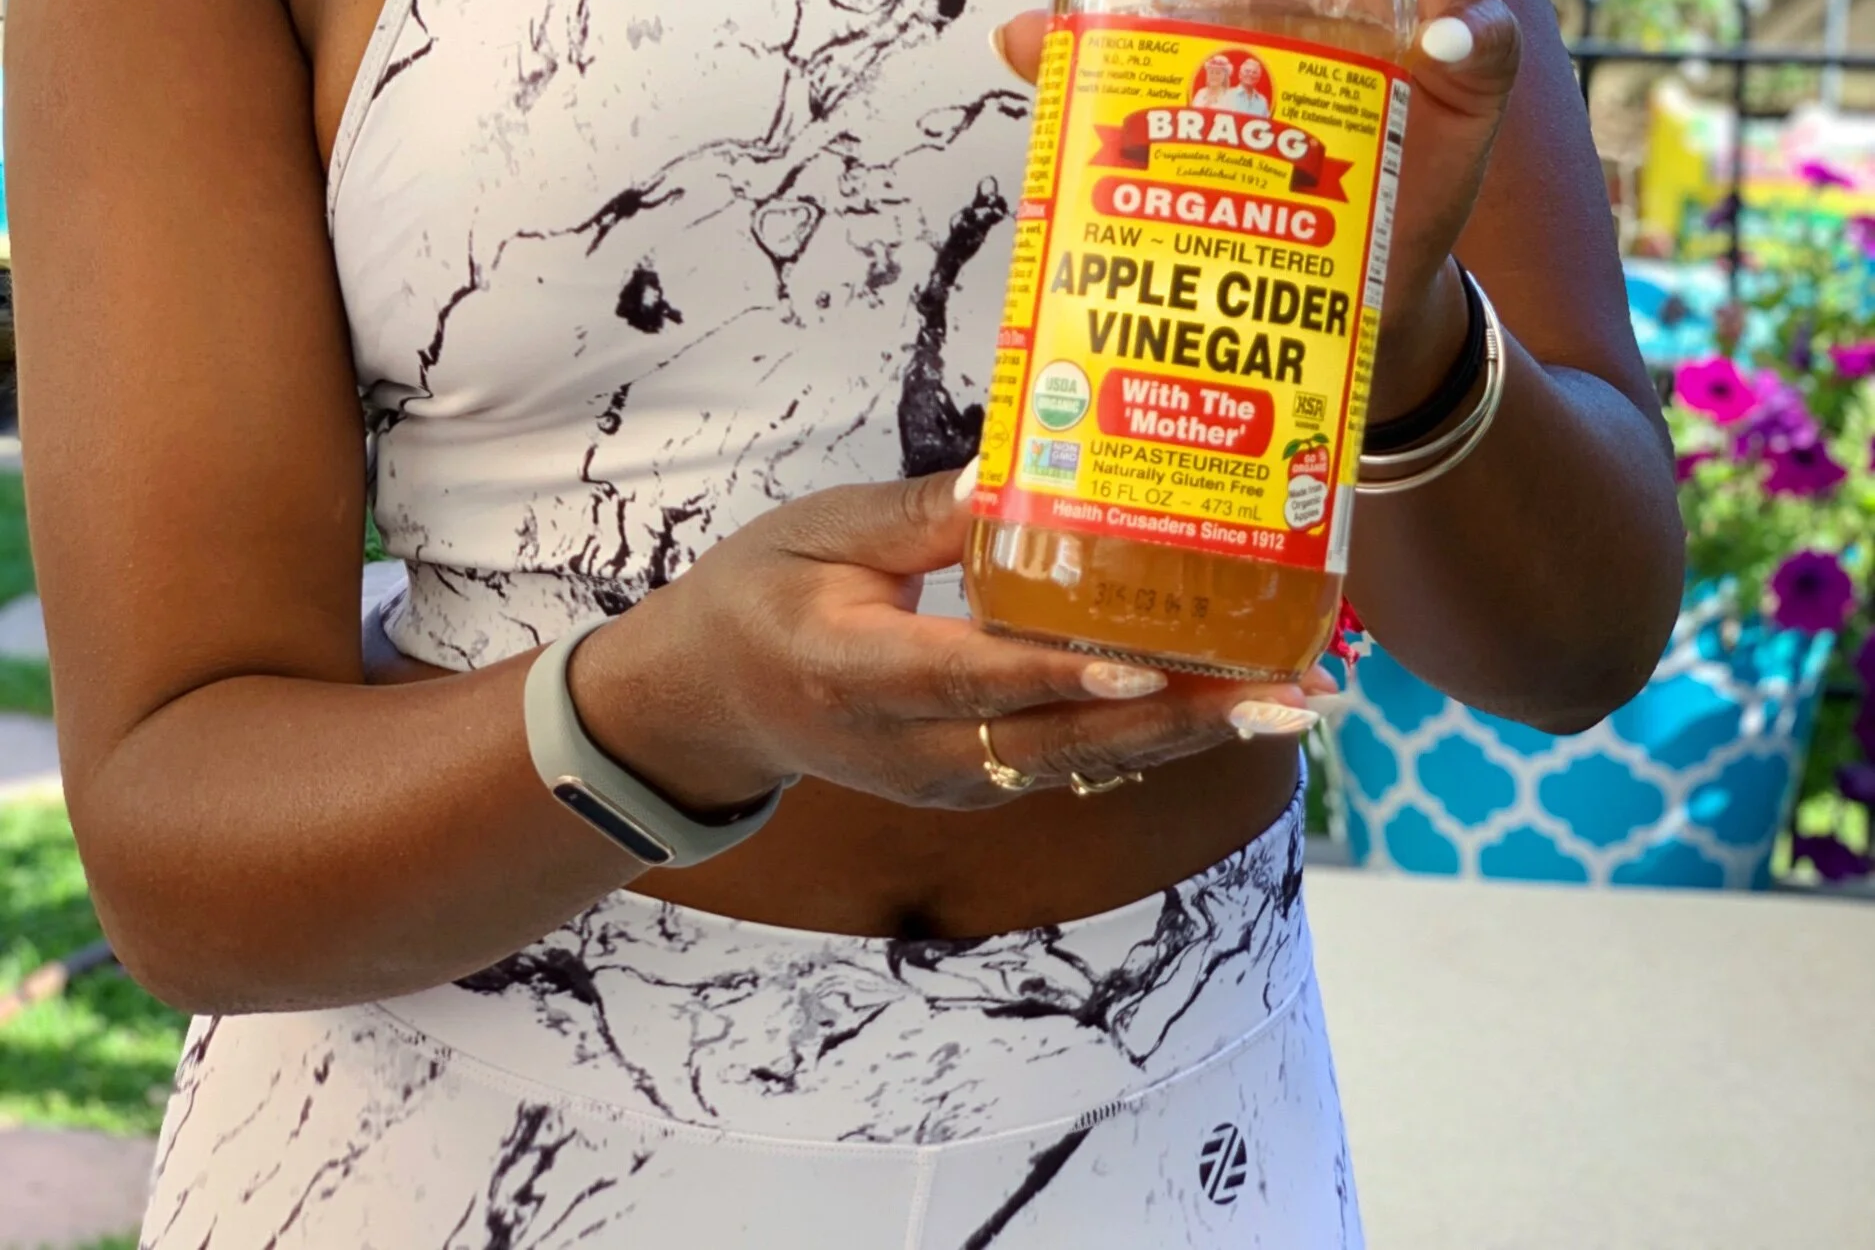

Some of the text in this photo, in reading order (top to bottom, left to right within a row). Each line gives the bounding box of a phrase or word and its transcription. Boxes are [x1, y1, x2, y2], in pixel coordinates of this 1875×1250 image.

[1138, 39, 1180, 54] BRAGG
[1139, 71, 1184, 85] Crusader
[1297, 61, 1328, 79] PAUL
[1346, 71, 1378, 90] BRAGG
[1146, 88, 1182, 100] Author
[1281, 91, 1330, 109] Originator
[1332, 101, 1359, 115] Health
[1282, 106, 1299, 120] Life
[1301, 110, 1343, 127] Extension
[1146, 109, 1309, 161] BRAGG
[1154, 149, 1210, 162] Originator
[1215, 151, 1253, 168] Health
[1176, 166, 1268, 189] Established 1912
[1112, 182, 1318, 240] ORGANIC
[1083, 222, 1143, 248] RAW
[1173, 233, 1335, 279] UNFILTERED
[1051, 250, 1350, 337] APPLE CIDER
[1087, 308, 1306, 385] VINEGAR
[1045, 376, 1078, 394] USDA
[1121, 376, 1256, 421] With The
[1051, 450, 1078, 463] GMO
[1052, 440, 1078, 452] NON
[1090, 438, 1271, 482] UNPASTEURIZED
[1092, 459, 1166, 486] Naturally
[1170, 470, 1225, 492] Gluten
[1229, 479, 1265, 498] Free
[1090, 479, 1113, 499] 16
[1117, 483, 1139, 502] FL
[1144, 487, 1174, 508] OZ
[1200, 497, 1233, 517] 473
[1237, 503, 1263, 522] mL
[1291, 496, 1322, 511] Organic
[1052, 498, 1286, 551] Health Crusaders Since 1912
